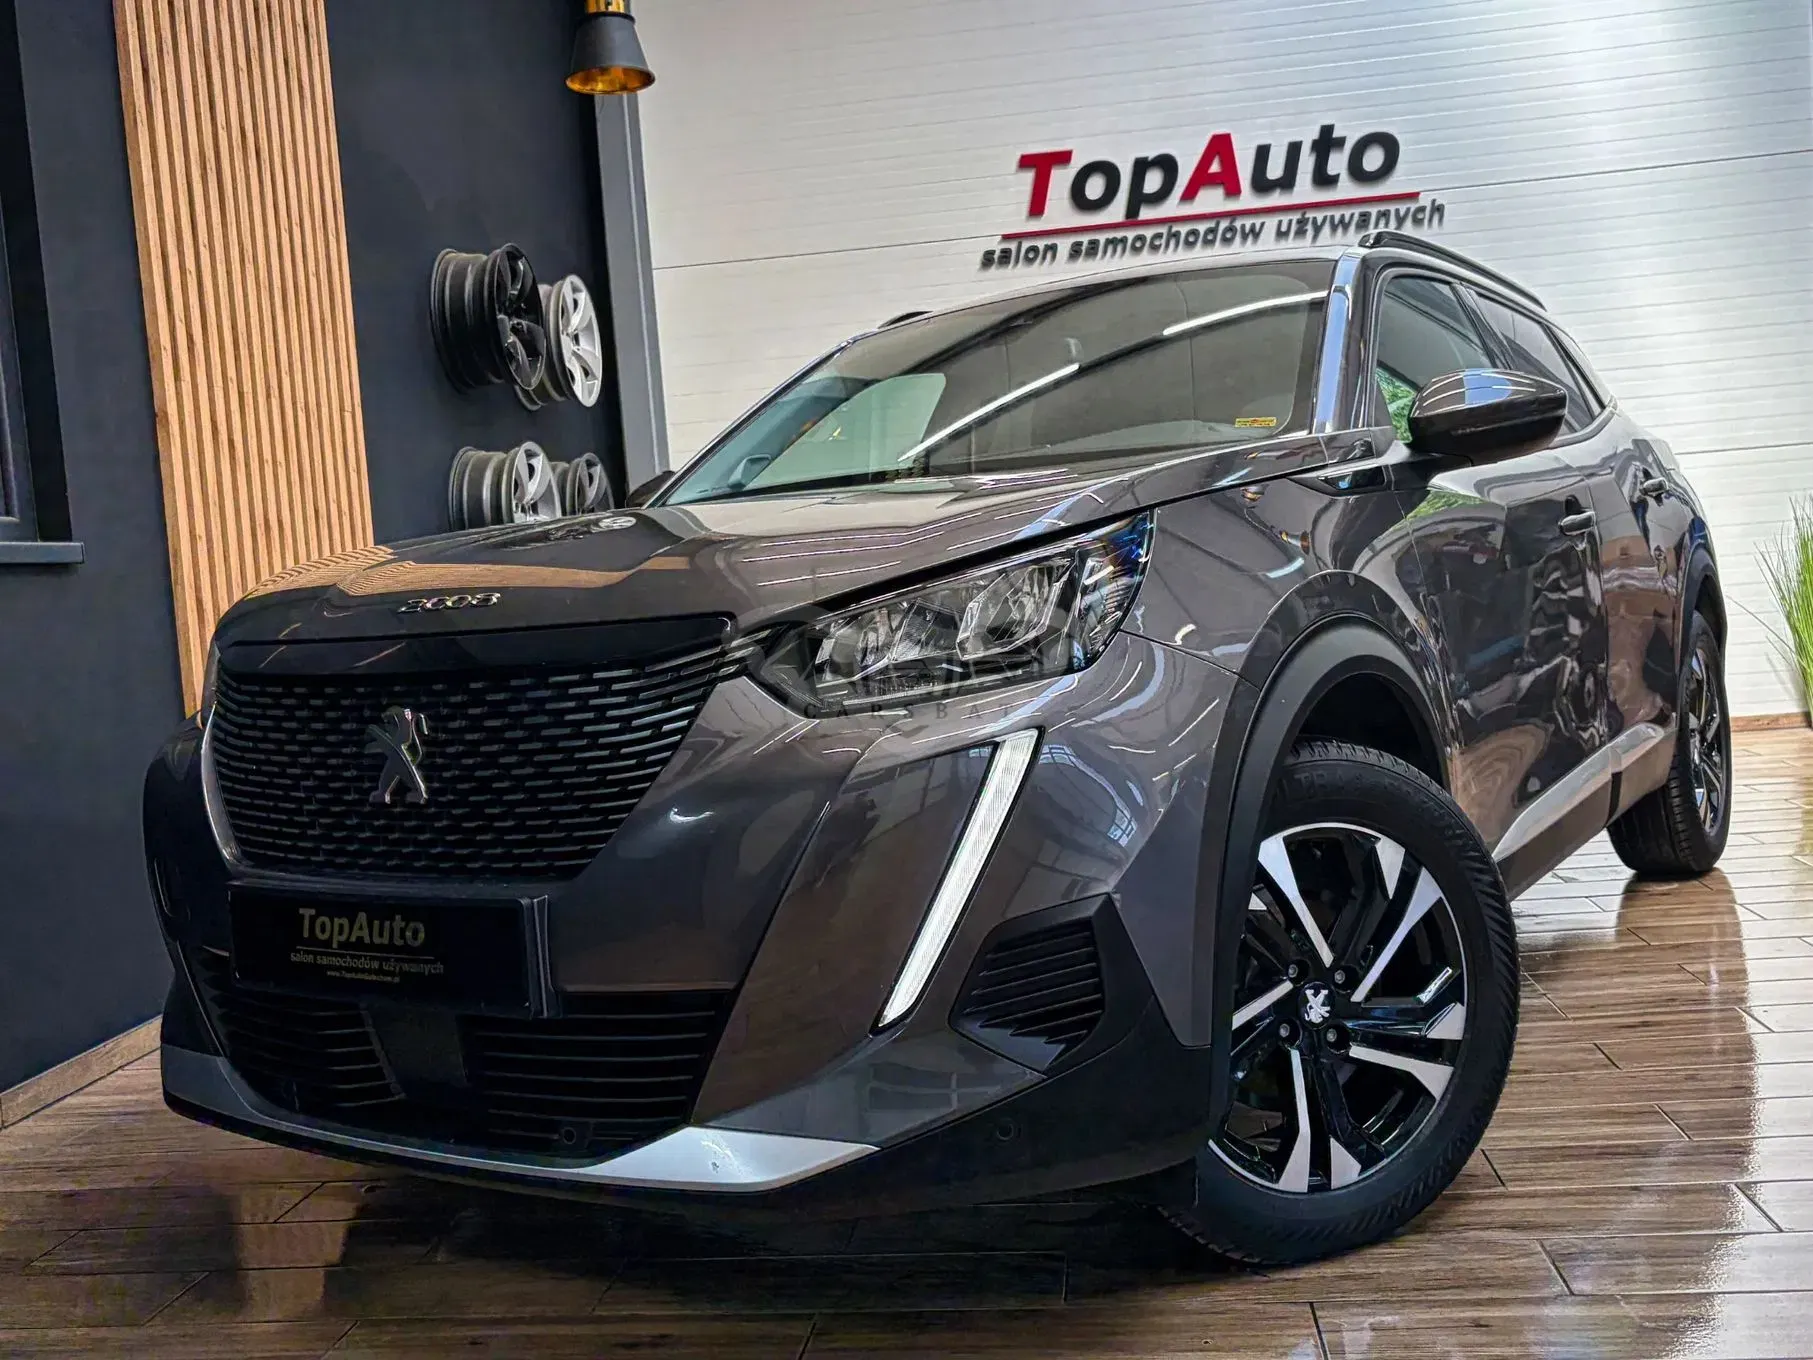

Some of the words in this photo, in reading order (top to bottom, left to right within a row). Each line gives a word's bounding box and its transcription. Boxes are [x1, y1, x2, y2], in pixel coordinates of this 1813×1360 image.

[1018, 123, 1401, 219] TopAuto
[980, 238, 1058, 269] salon
[1068, 218, 1265, 260] samochodów
[1275, 199, 1445, 241] używanych
[398, 592, 500, 612] 2008
[299, 908, 425, 948] TopAuto
[290, 951, 314, 964] salon
[316, 955, 379, 969] samochodów
